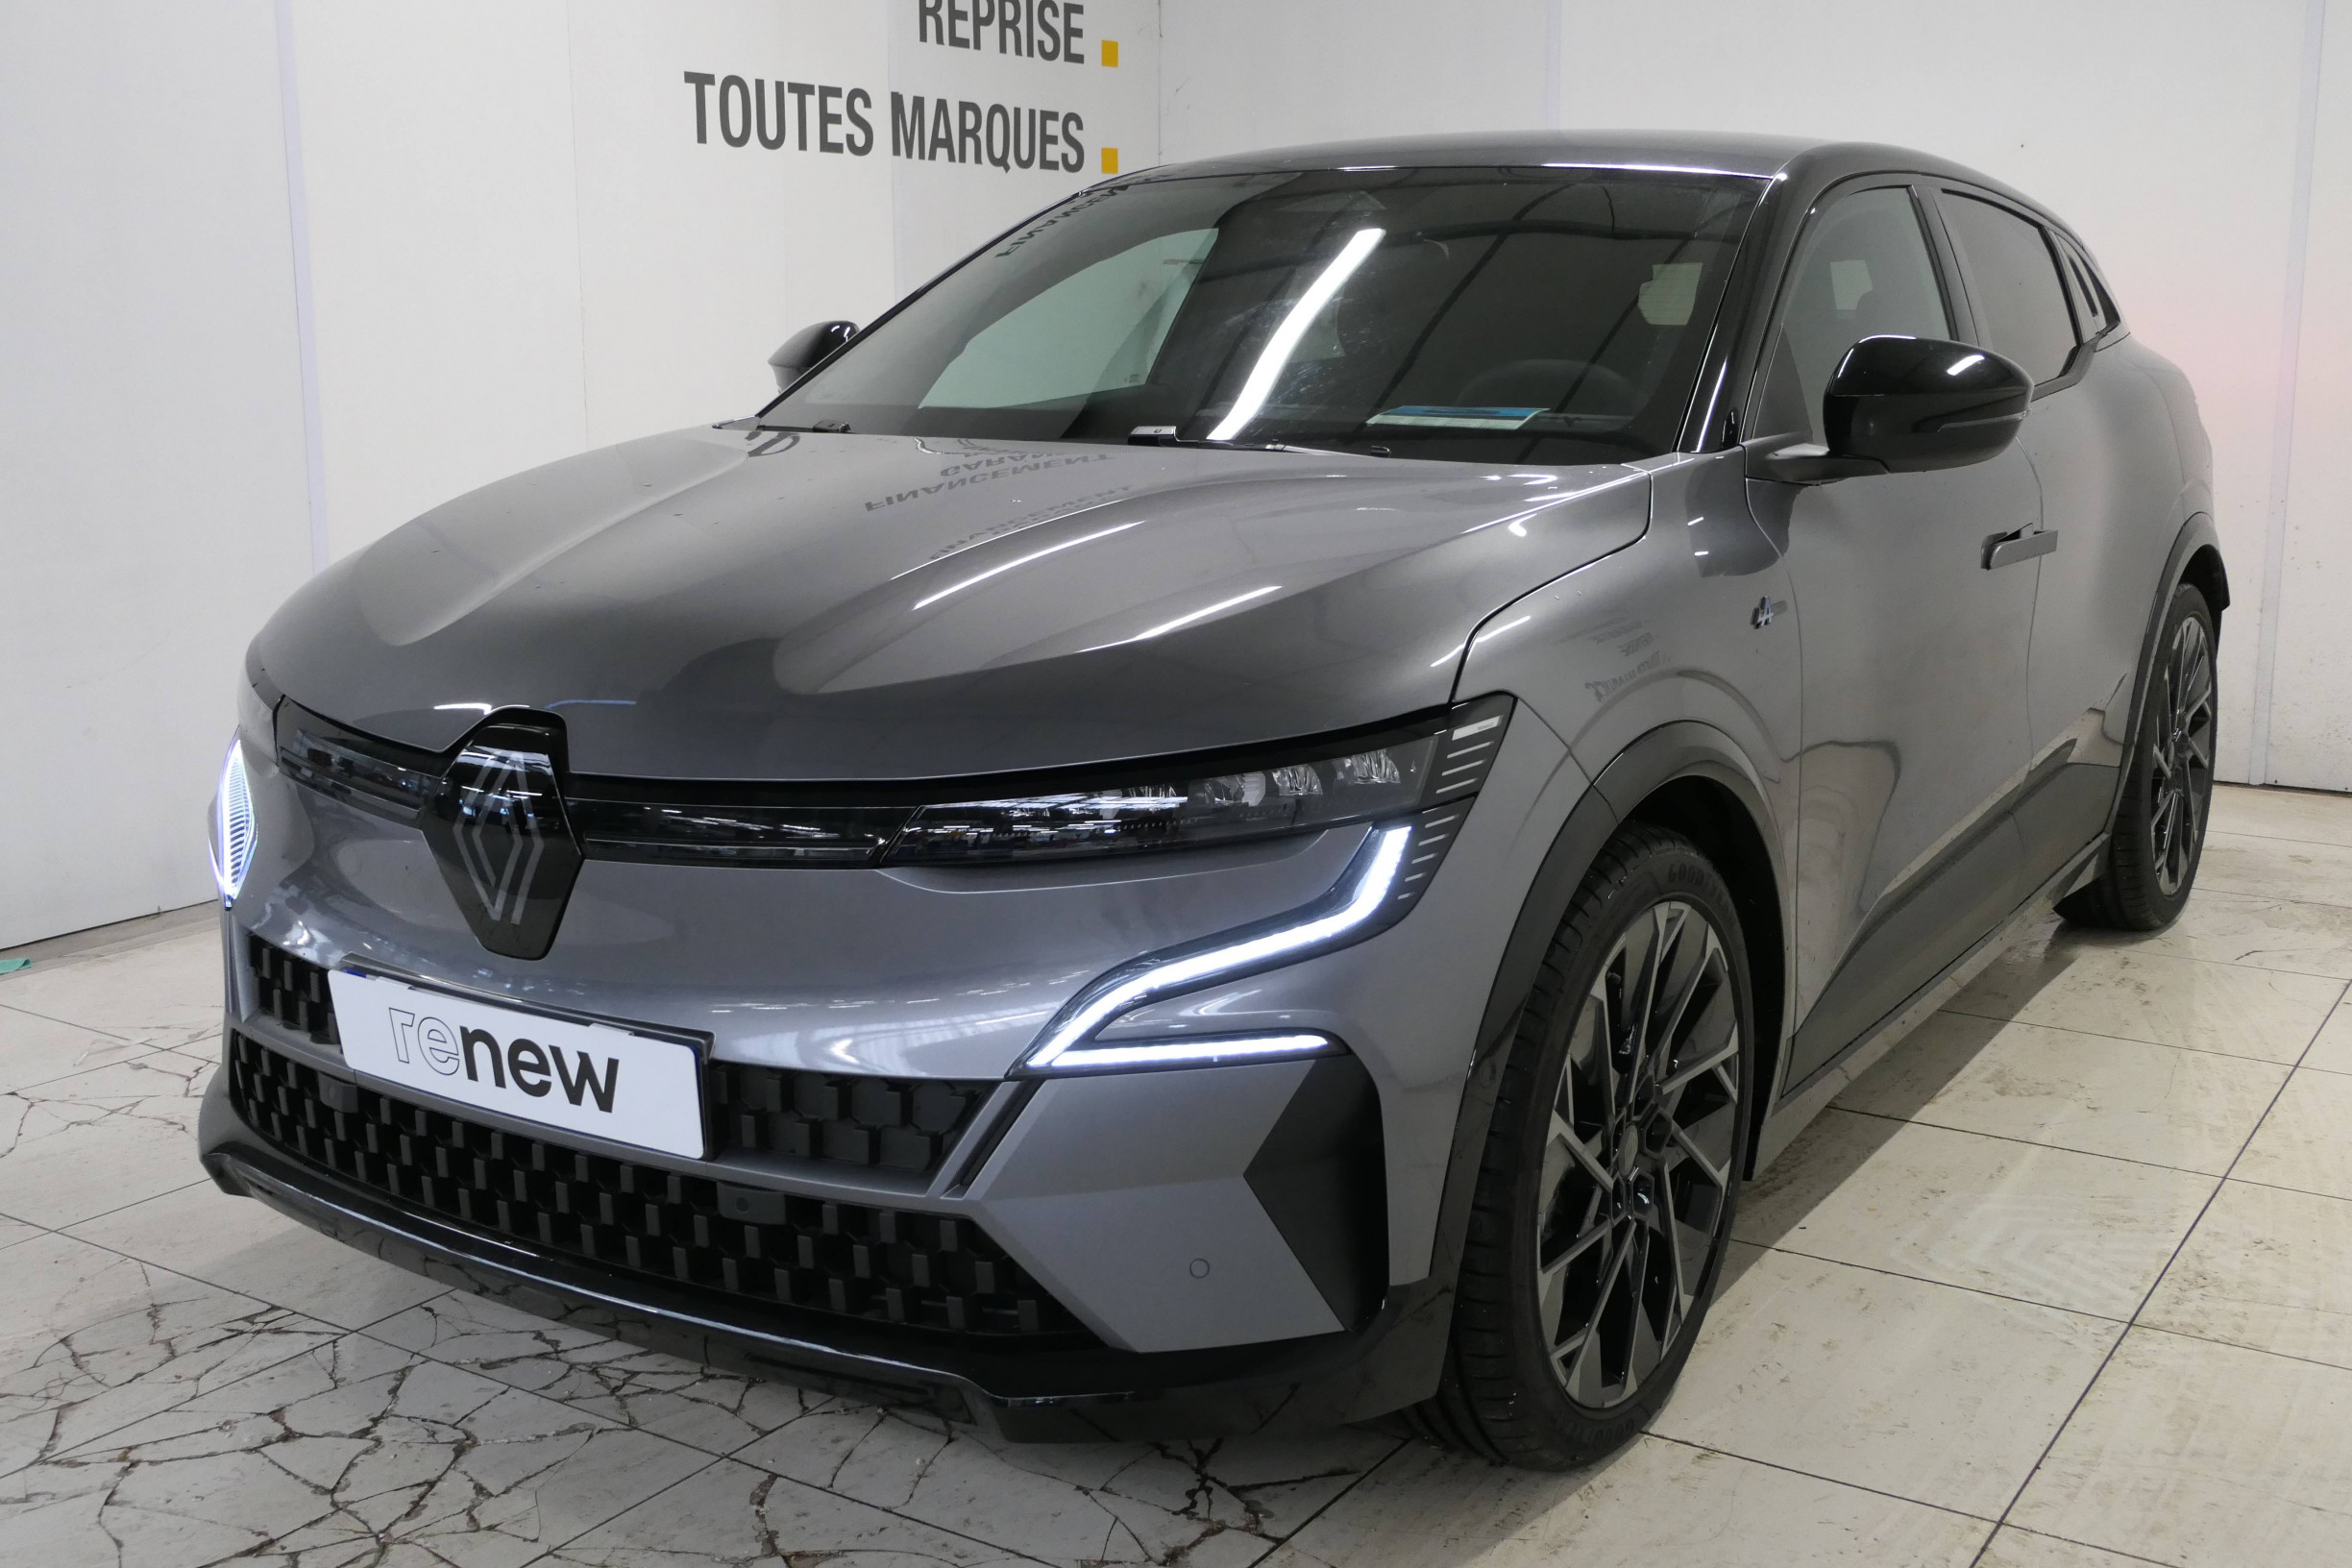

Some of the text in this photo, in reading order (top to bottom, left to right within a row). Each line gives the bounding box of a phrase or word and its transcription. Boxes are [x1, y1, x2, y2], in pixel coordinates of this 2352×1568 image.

[919, 0, 1085, 64] REPRISE
[683, 71, 1085, 174] TOUTES MARQUES
[388, 1007, 620, 1115] renew
